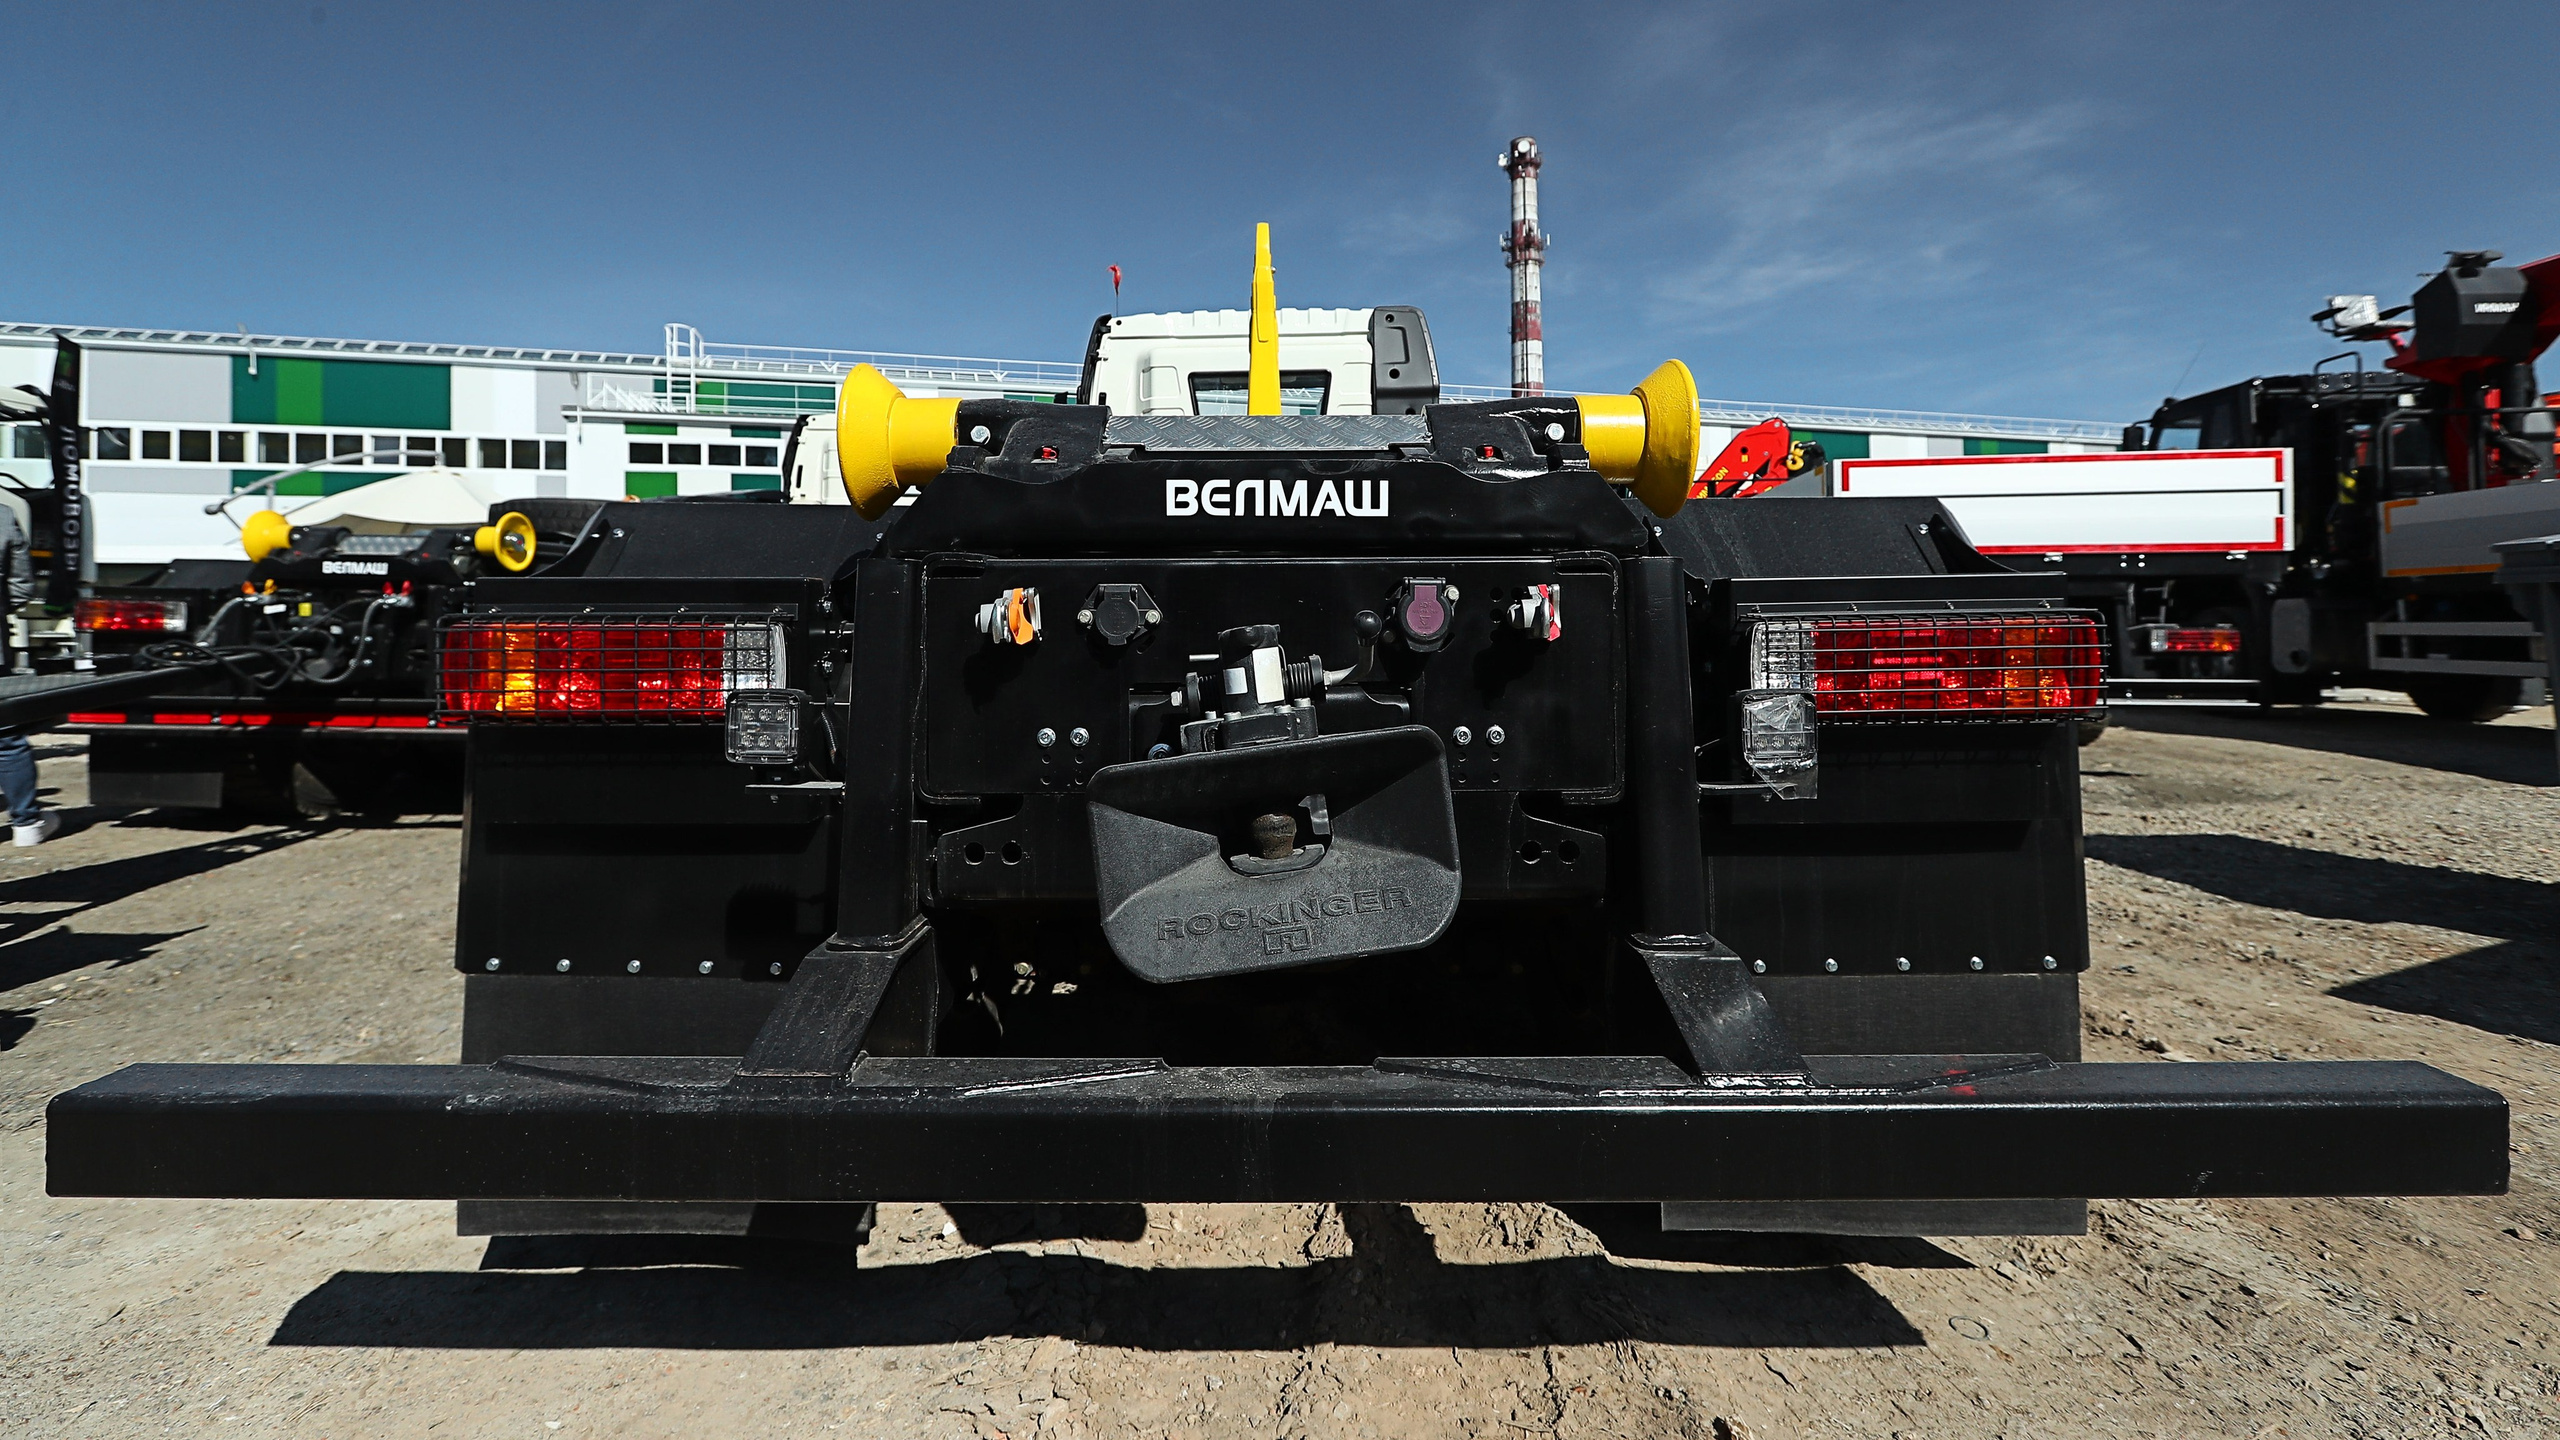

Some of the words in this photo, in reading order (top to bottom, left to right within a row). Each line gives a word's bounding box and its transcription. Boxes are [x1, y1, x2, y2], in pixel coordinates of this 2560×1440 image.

[1166, 479, 1389, 517] ВЕЛМАШ
[322, 561, 388, 575] ВЕЛМАШ
[1157, 886, 1413, 940] ROCKINGER
